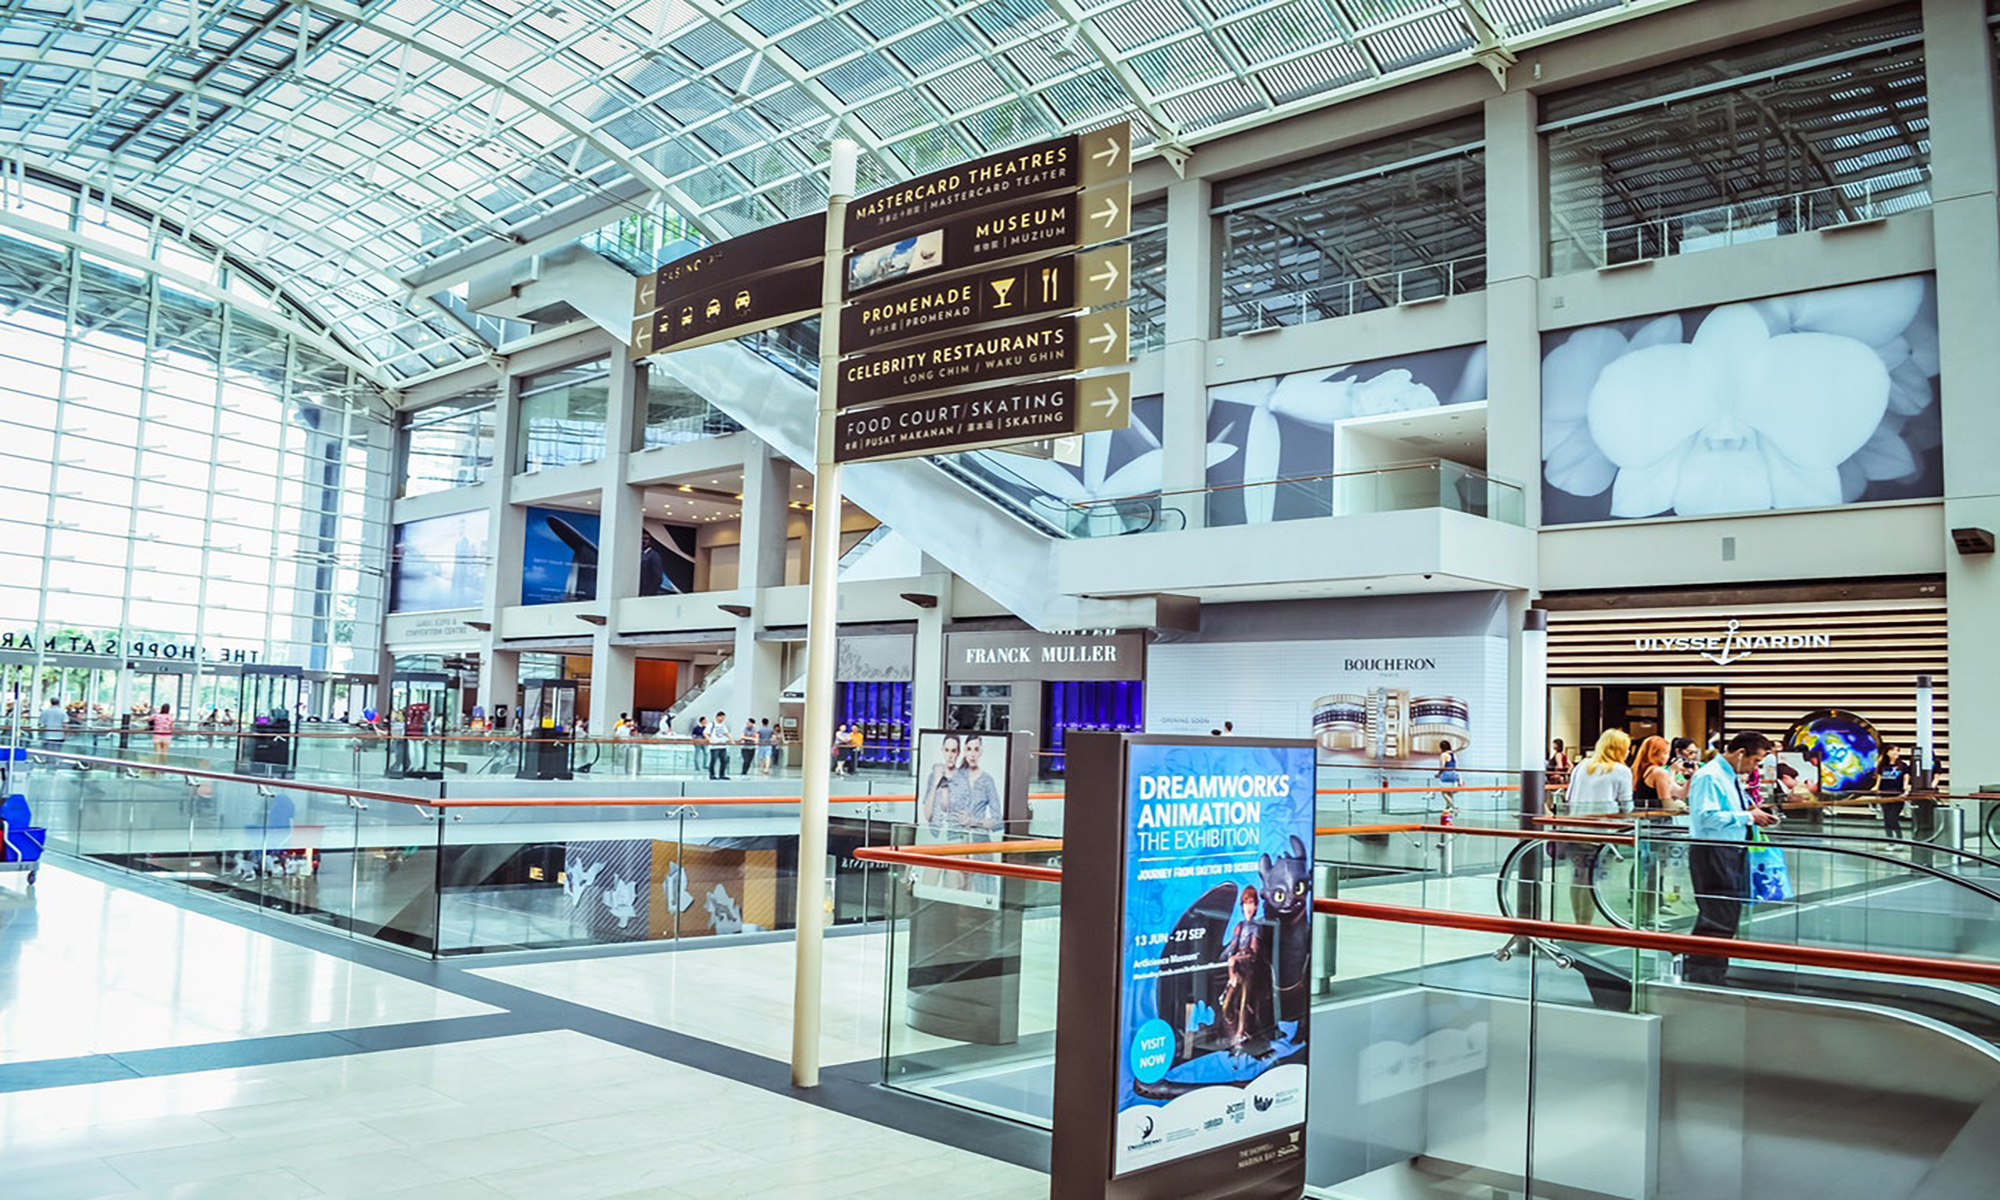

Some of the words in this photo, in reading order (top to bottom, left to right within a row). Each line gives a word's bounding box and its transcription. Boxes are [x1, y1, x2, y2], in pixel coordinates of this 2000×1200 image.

[856, 175, 960, 220] MASTERCARD
[968, 147, 1068, 184] THEATRES
[930, 181, 1010, 209] MASTERCARD
[1016, 167, 1067, 187] TEATER
[975, 206, 1066, 238] MUSEUM
[1011, 226, 1066, 246] MUZIUM
[862, 285, 972, 324] PROMENADE
[906, 306, 970, 327] PROMENAD
[847, 352, 926, 382] CELEBRITY
[933, 329, 1064, 364] RESTAURANTS
[903, 370, 934, 385] LONG
[939, 364, 970, 379] CHIM
[985, 355, 1023, 369] WAKU
[1029, 349, 1065, 363] GHIN
[847, 415, 892, 436] FOOD
[1005, 411, 1064, 428] SKATING
[865, 433, 896, 448] PUSAT
[900, 424, 955, 442] MAKANAN
[1634, 637, 1722, 651] ULYSSE
[1735, 634, 1831, 649] NARDIN
[965, 646, 1031, 664] FRANCK
[1041, 645, 1117, 663] MULLER
[1344, 658, 1436, 671] BOUCHERON
[1140, 774, 1290, 800] DREAMWORKS
[1137, 801, 1260, 828] ANIMATION
[1137, 831, 1170, 851] THE
[1174, 827, 1260, 850] EXHIBITION
[1173, 866, 1194, 878] FROM
[1135, 934, 1147, 947] 13
[1148, 932, 1169, 945] JUN
[1175, 929, 1188, 942] 27
[1188, 927, 1206, 940] SEP
[1140, 1036, 1166, 1051] VISIT
[1139, 1053, 1166, 1069] NOW
